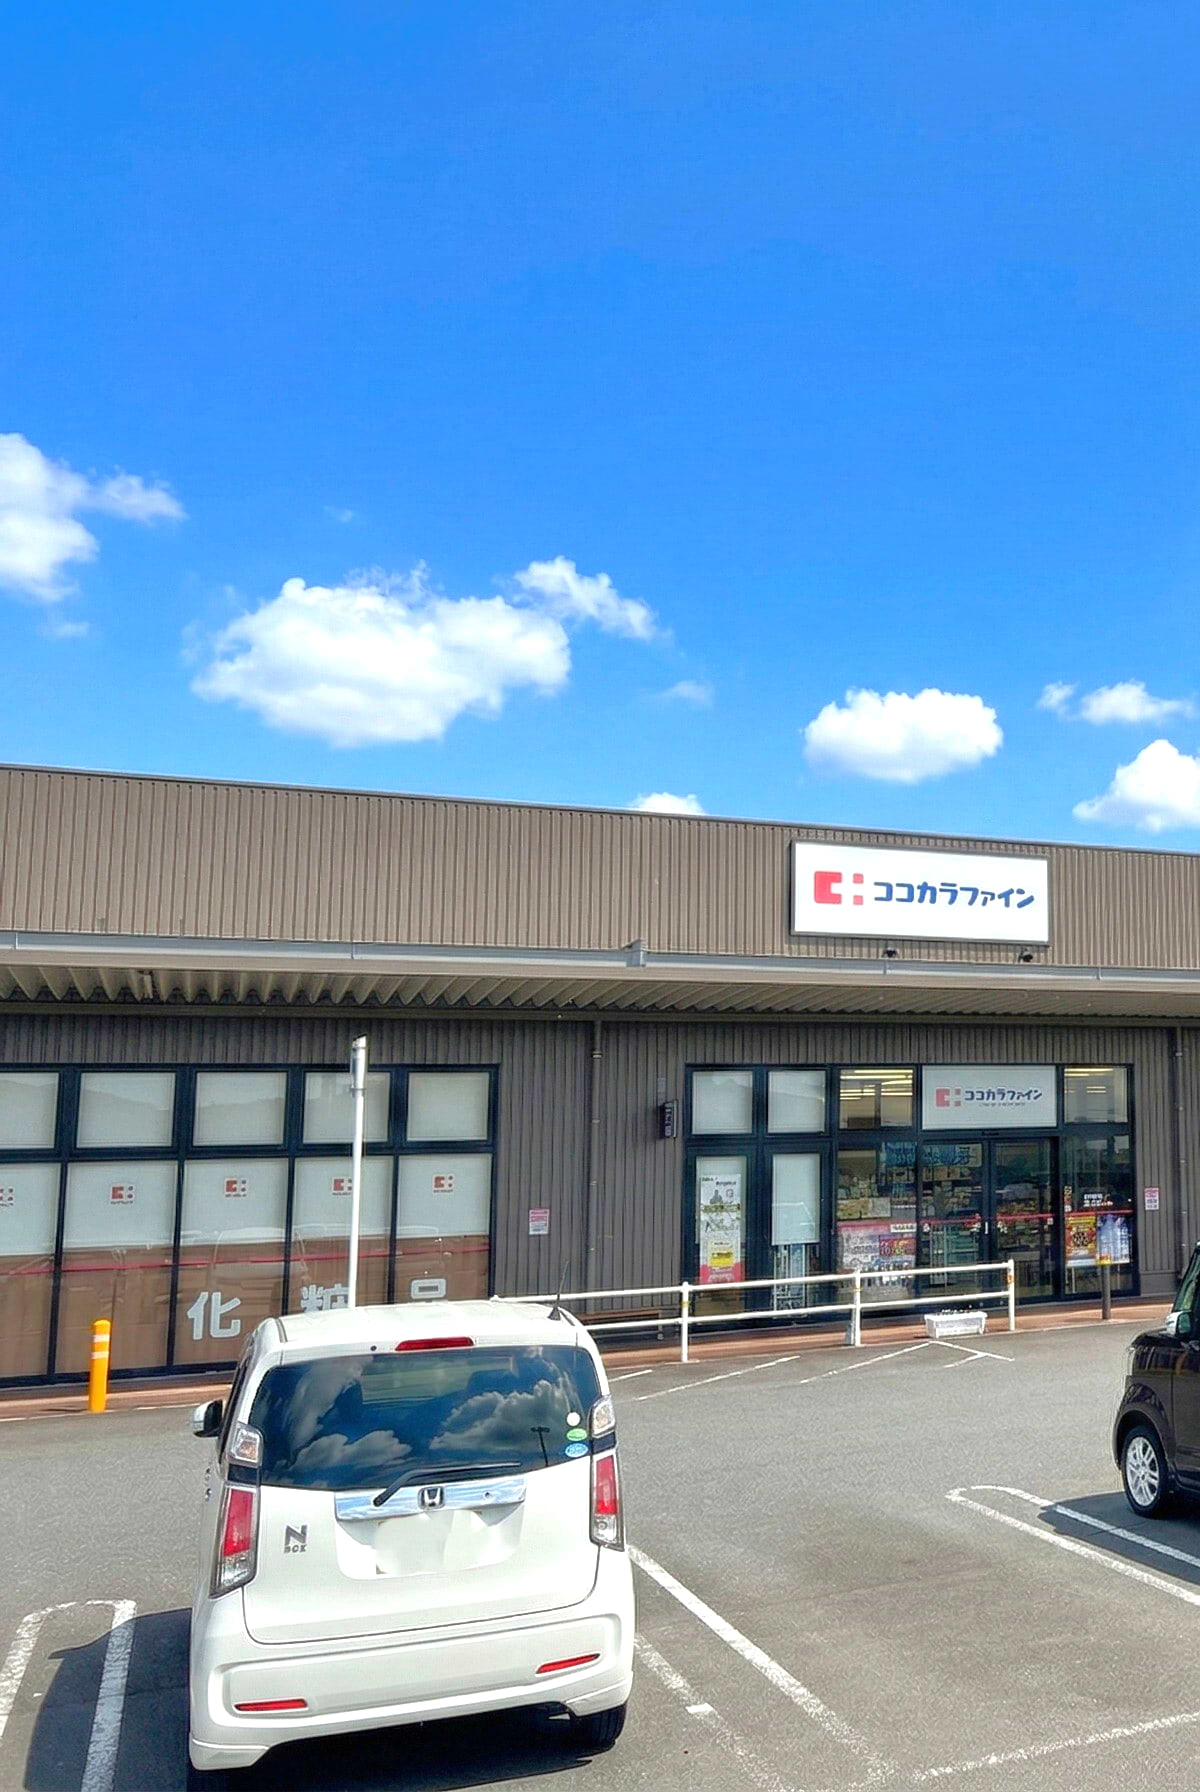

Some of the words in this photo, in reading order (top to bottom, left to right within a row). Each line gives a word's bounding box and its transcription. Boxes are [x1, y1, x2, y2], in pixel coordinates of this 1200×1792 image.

[873, 881, 1035, 909] ココカラファイン
[964, 1088, 1043, 1102] ココカラファイン
